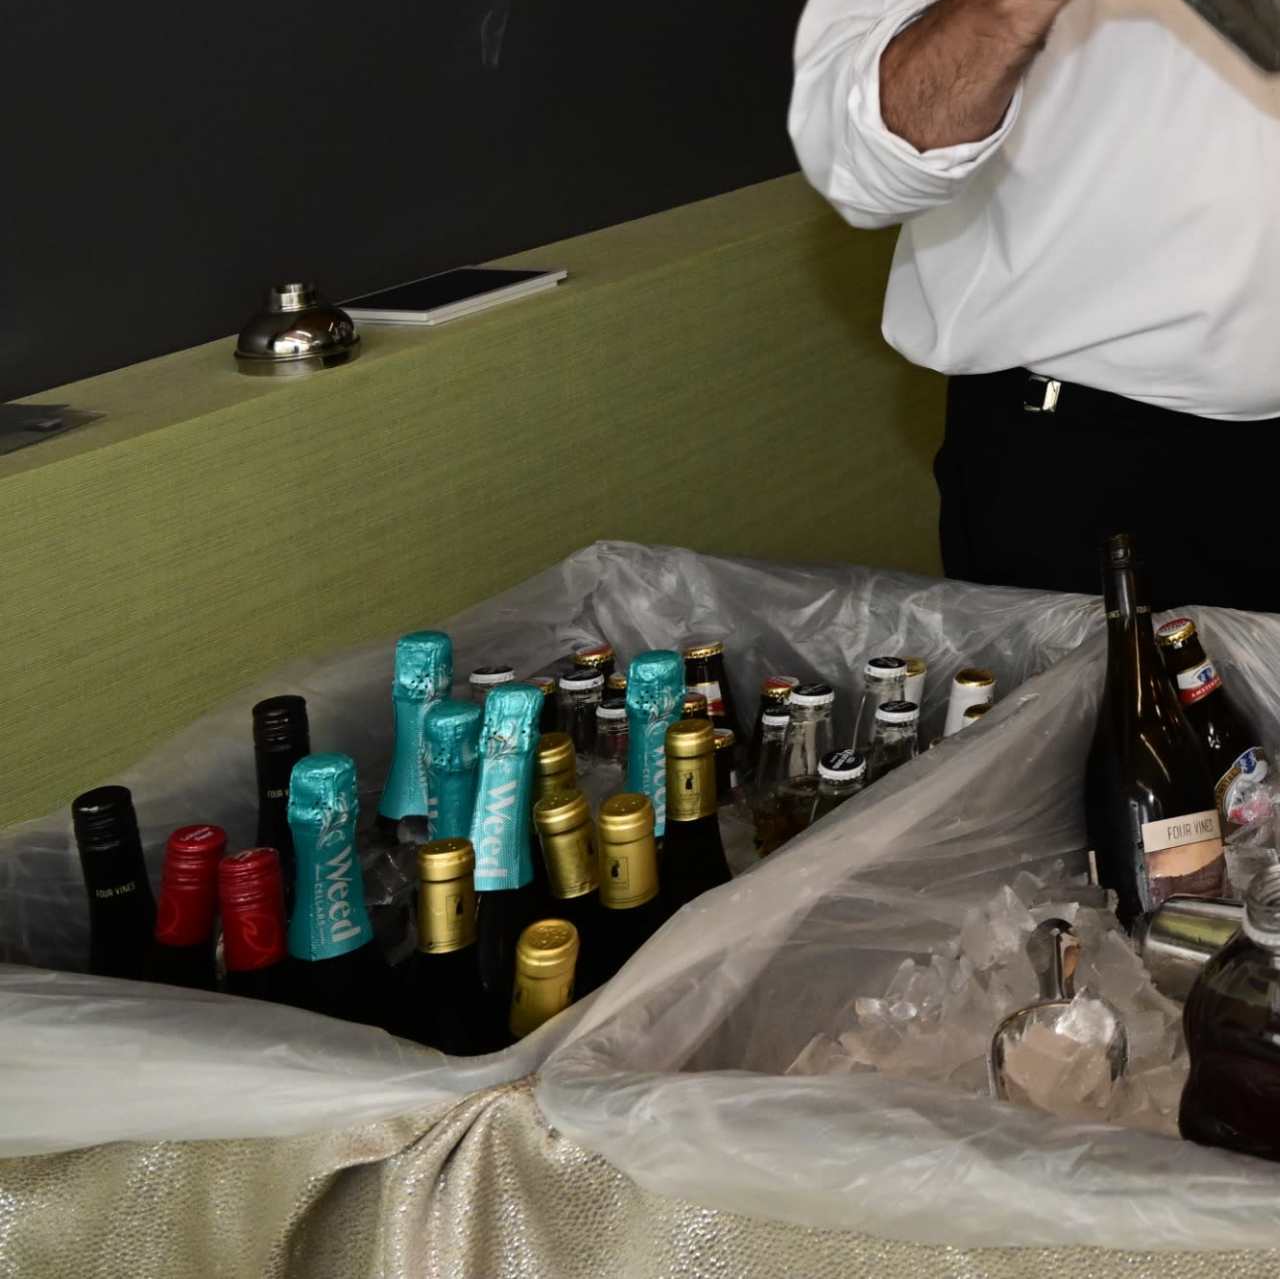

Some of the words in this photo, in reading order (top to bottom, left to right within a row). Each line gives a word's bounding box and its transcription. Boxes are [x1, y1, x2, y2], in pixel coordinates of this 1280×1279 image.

[473, 780, 518, 879] Weed
[1167, 824, 1192, 841] FOUR
[326, 843, 362, 943] Weed
